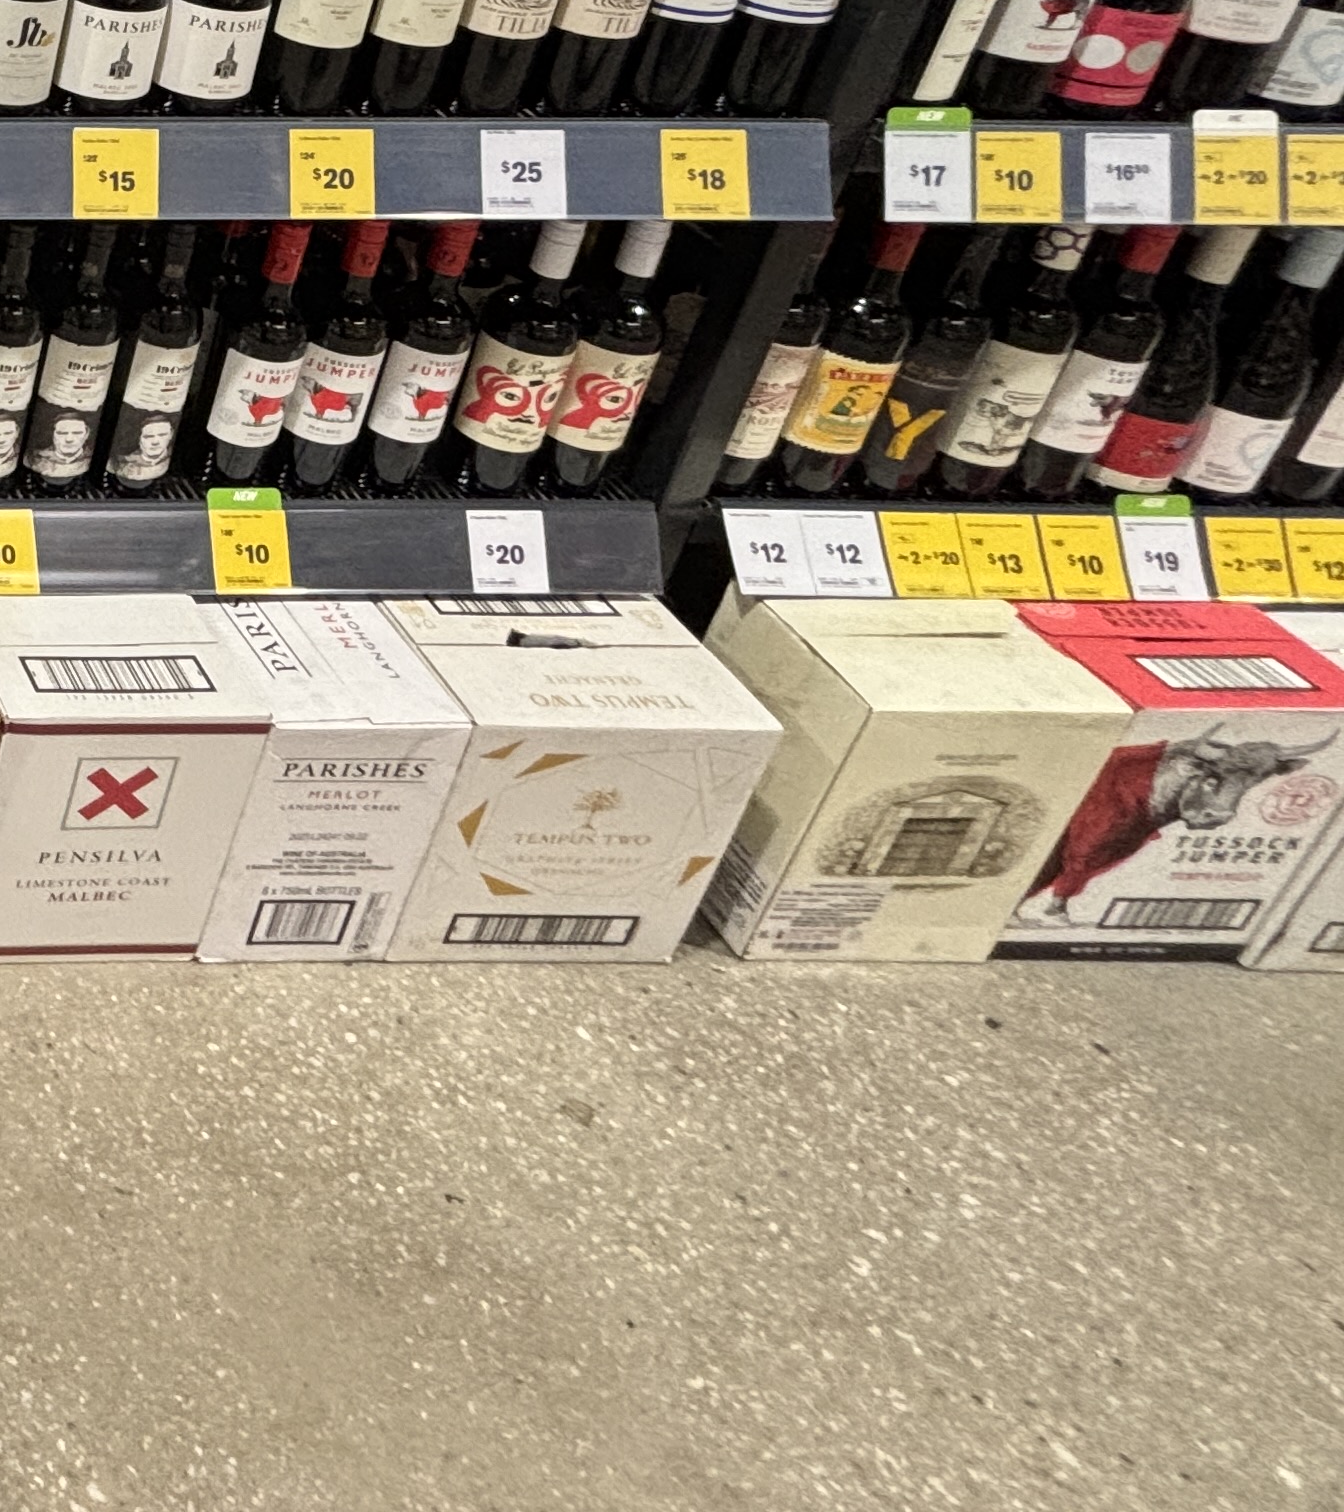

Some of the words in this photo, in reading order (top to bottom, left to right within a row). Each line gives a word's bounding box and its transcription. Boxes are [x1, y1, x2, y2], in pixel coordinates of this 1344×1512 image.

[98, 169, 136, 193] $15
[312, 167, 355, 190] $20
[500, 159, 543, 184] $25
[687, 167, 727, 191] $18
[909, 163, 947, 187] $17
[994, 167, 1034, 192] $10
[306, 362, 377, 380] JUMPER
[231, 489, 258, 502] NEW
[234, 544, 270, 565] $10
[485, 544, 525, 565] $20
[750, 541, 788, 565] $12
[825, 542, 863, 565] $12
[987, 552, 1024, 575] $13
[1144, 550, 1180, 573] $19
[1066, 553, 1104, 576] $10
[281, 761, 429, 780] PARISHES
[306, 788, 383, 801] MERLOT
[513, 831, 597, 848] TEMPUS
[602, 833, 652, 847] TWO
[1176, 834, 1303, 852] TUSSOCK
[37, 848, 164, 866] PENSILVA
[1170, 849, 1288, 865] JUMPER
[15, 877, 112, 889] LIMESTONE
[116, 876, 172, 889] COAST
[46, 889, 133, 904] MALBEC
